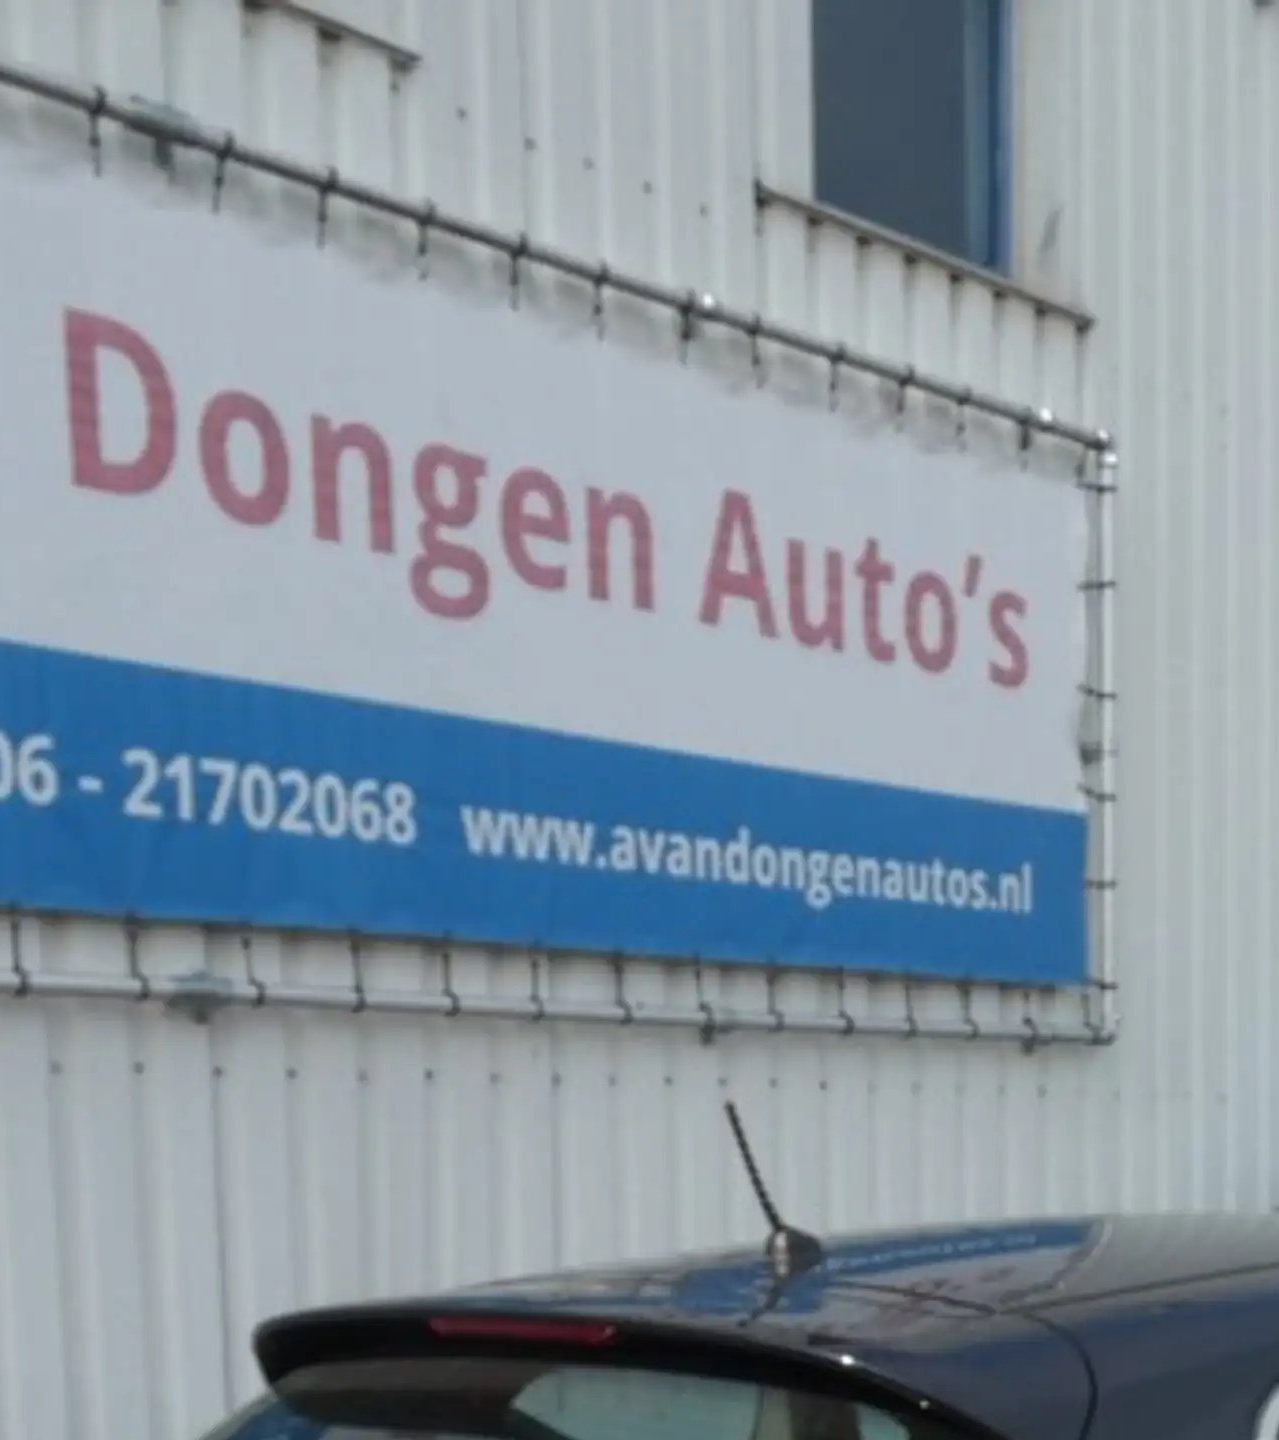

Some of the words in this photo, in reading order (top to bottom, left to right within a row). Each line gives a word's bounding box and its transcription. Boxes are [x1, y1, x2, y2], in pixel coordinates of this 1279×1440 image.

[63, 305, 655, 620] Dongen
[699, 489, 1030, 689] Auto's
[123, 748, 416, 844] 21702068
[461, 802, 1033, 914] www.avandongenautos.nl
